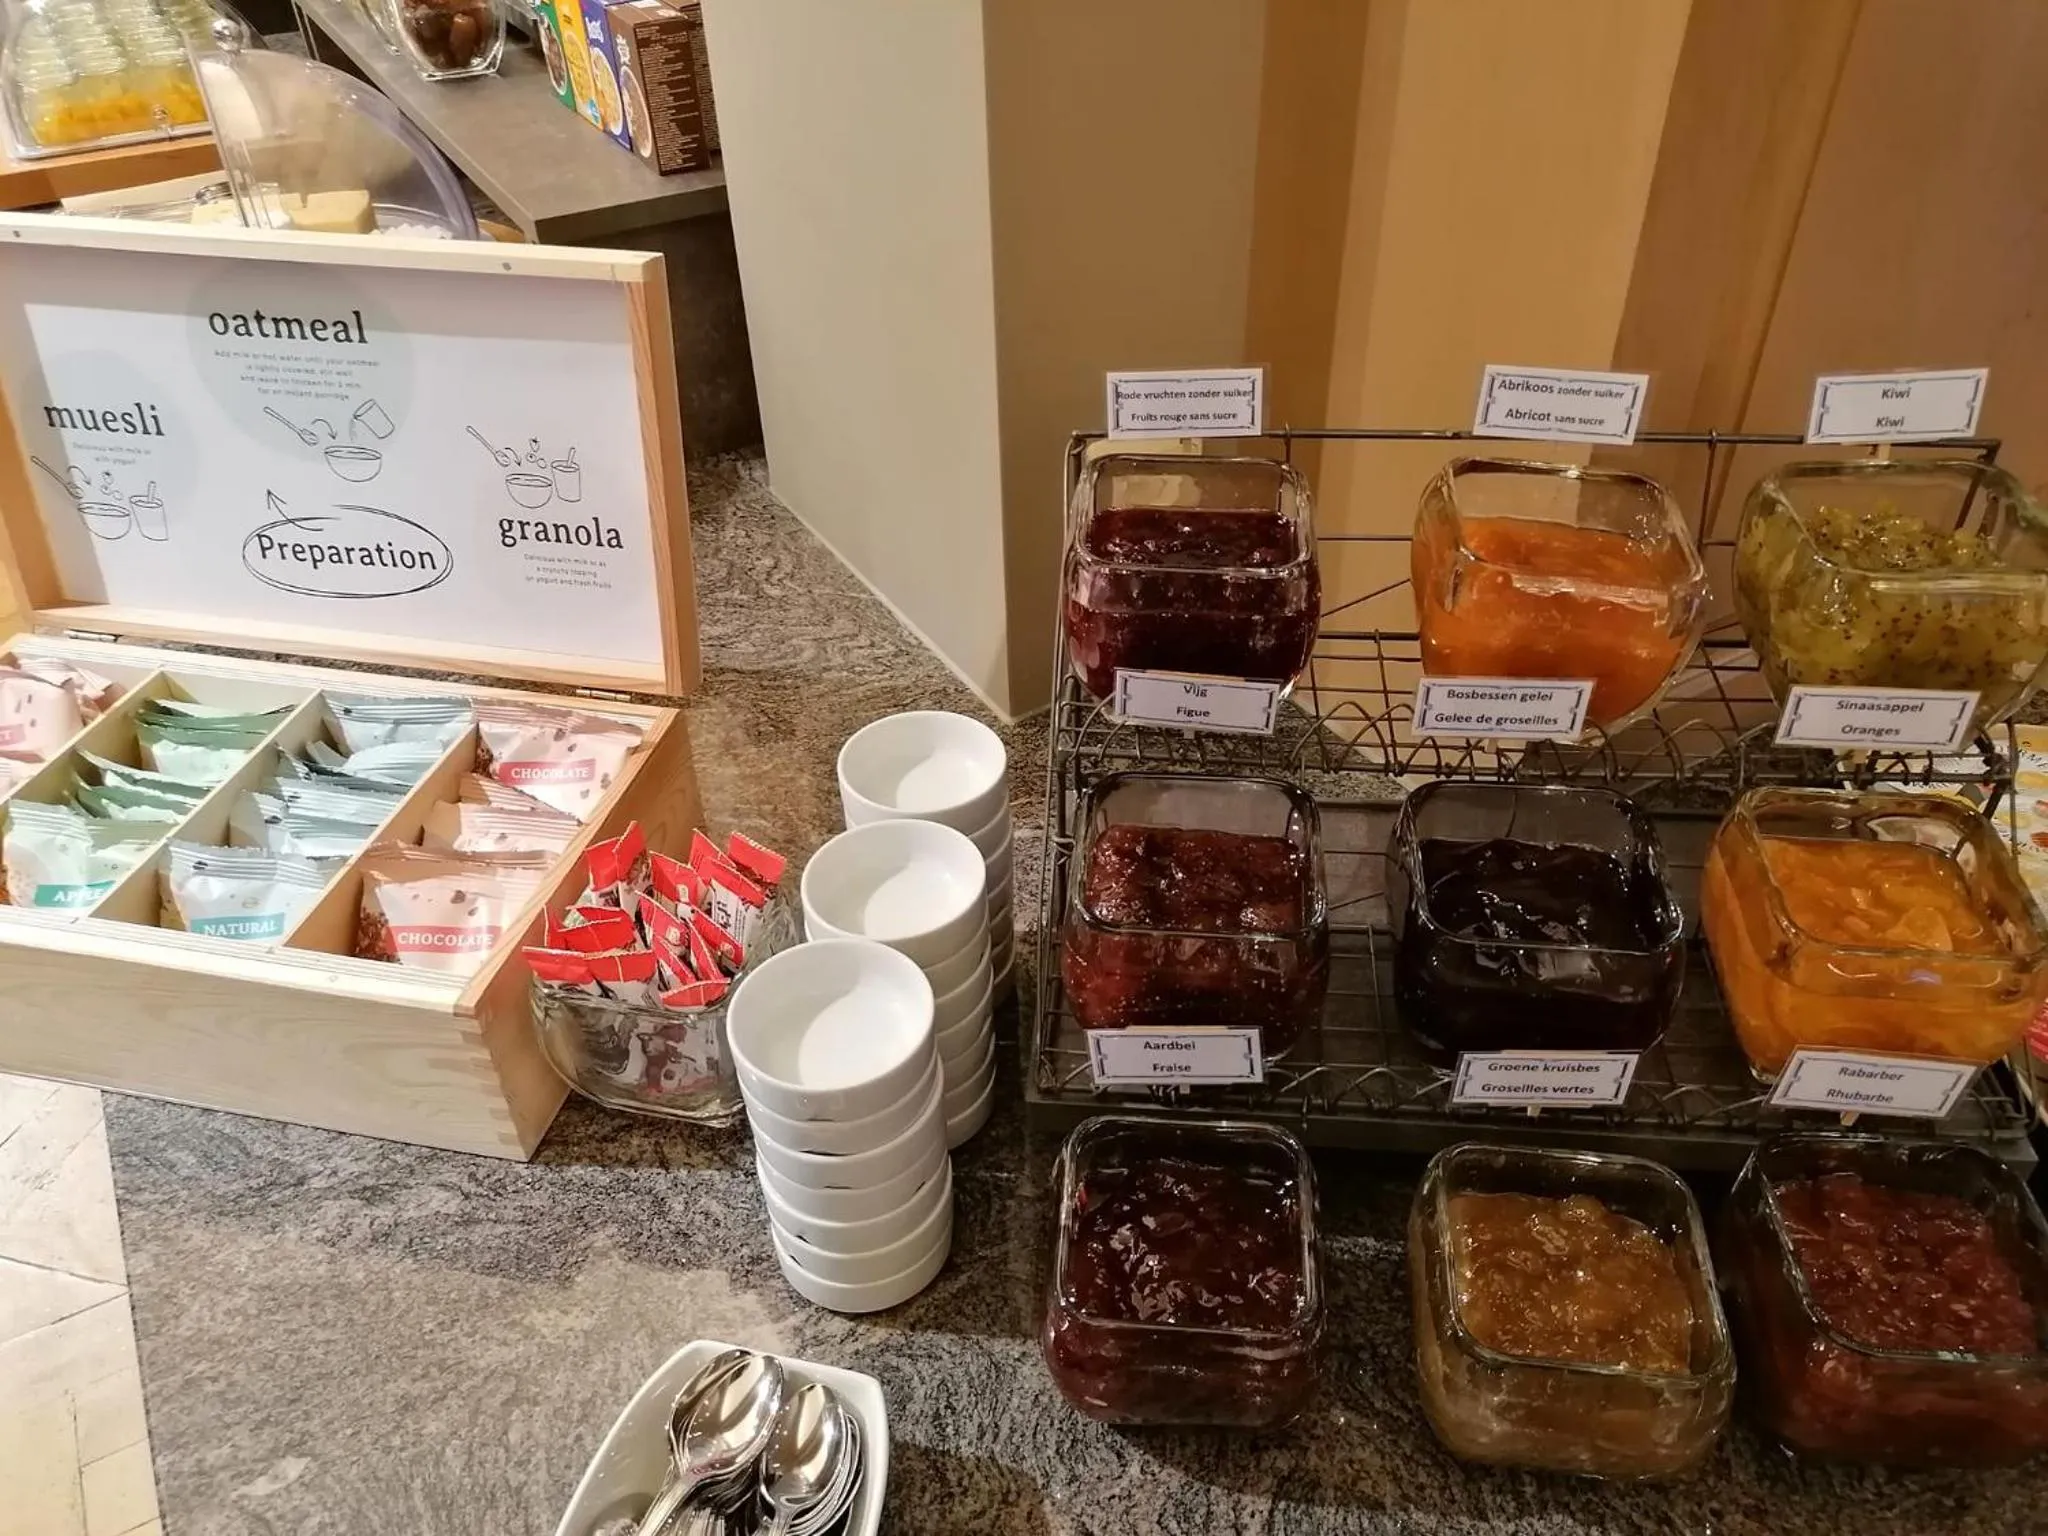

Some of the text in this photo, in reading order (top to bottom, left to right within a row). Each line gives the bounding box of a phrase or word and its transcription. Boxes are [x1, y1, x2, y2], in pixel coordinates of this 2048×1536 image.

[208, 308, 369, 344] oatmeal
[1144, 388, 1186, 399] vruchten
[1188, 387, 1221, 398] zonder
[1223, 387, 1253, 398] suiker
[1498, 379, 1625, 399] Abrikoos zonder suiker
[1881, 387, 1912, 400] Kiwi
[43, 402, 165, 436] muesli
[1131, 412, 1238, 423] Fruits rouge sans sucre
[1504, 408, 1605, 426] Abricot sans sucre
[1876, 416, 1905, 428] Kiwi
[498, 516, 624, 549] granola
[256, 533, 438, 570] Preparation
[1183, 685, 1209, 698] Vijg
[1446, 689, 1554, 703] Bosbessen gelei
[1176, 706, 1211, 718] Figue
[1836, 699, 1925, 713] Sinaasappel
[1434, 712, 1559, 726] Gelee de groseilles
[1840, 724, 1902, 737] Oranges
[510, 766, 592, 780] CHOCOLATE
[203, 920, 279, 937] NATURAL
[397, 931, 493, 947] CHOCOLATE
[1143, 1040, 1196, 1051] Aardbei
[1152, 1062, 1192, 1073] Fraise
[1487, 1062, 1601, 1074] Groene kruisbes
[1838, 1066, 1905, 1081] Rabarber
[1481, 1082, 1595, 1095] Groseilles vertes
[1825, 1087, 1895, 1104] Rhubarbe
